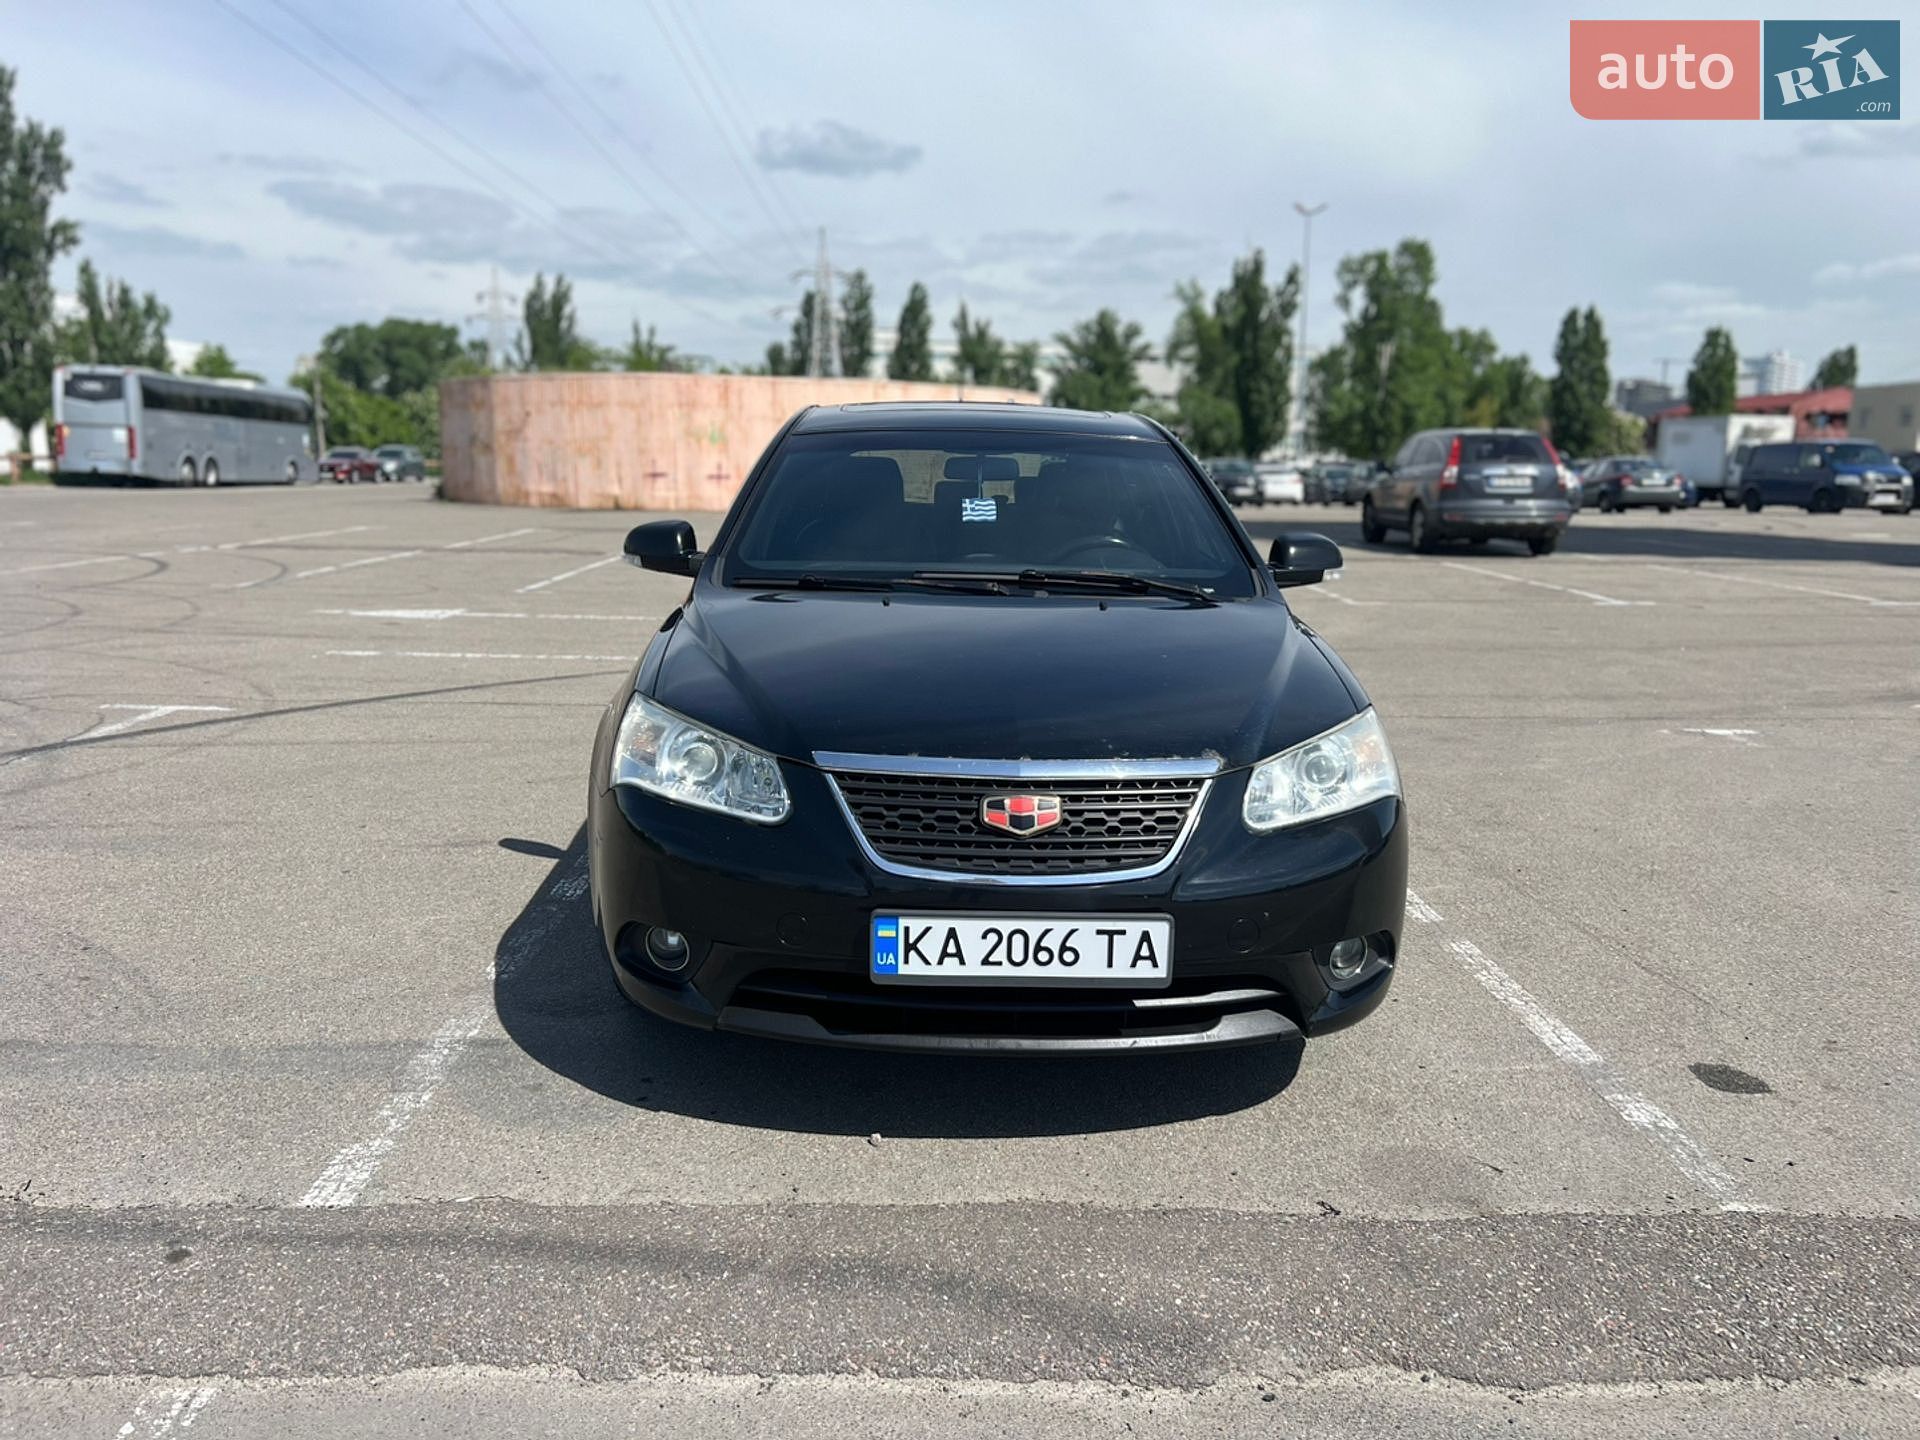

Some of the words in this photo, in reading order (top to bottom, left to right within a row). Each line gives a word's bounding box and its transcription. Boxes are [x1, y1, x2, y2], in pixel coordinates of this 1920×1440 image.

[877, 952, 896, 965] UA
[903, 925, 966, 966] KA
[980, 927, 1079, 967] 2066
[1096, 929, 1159, 968] TA
